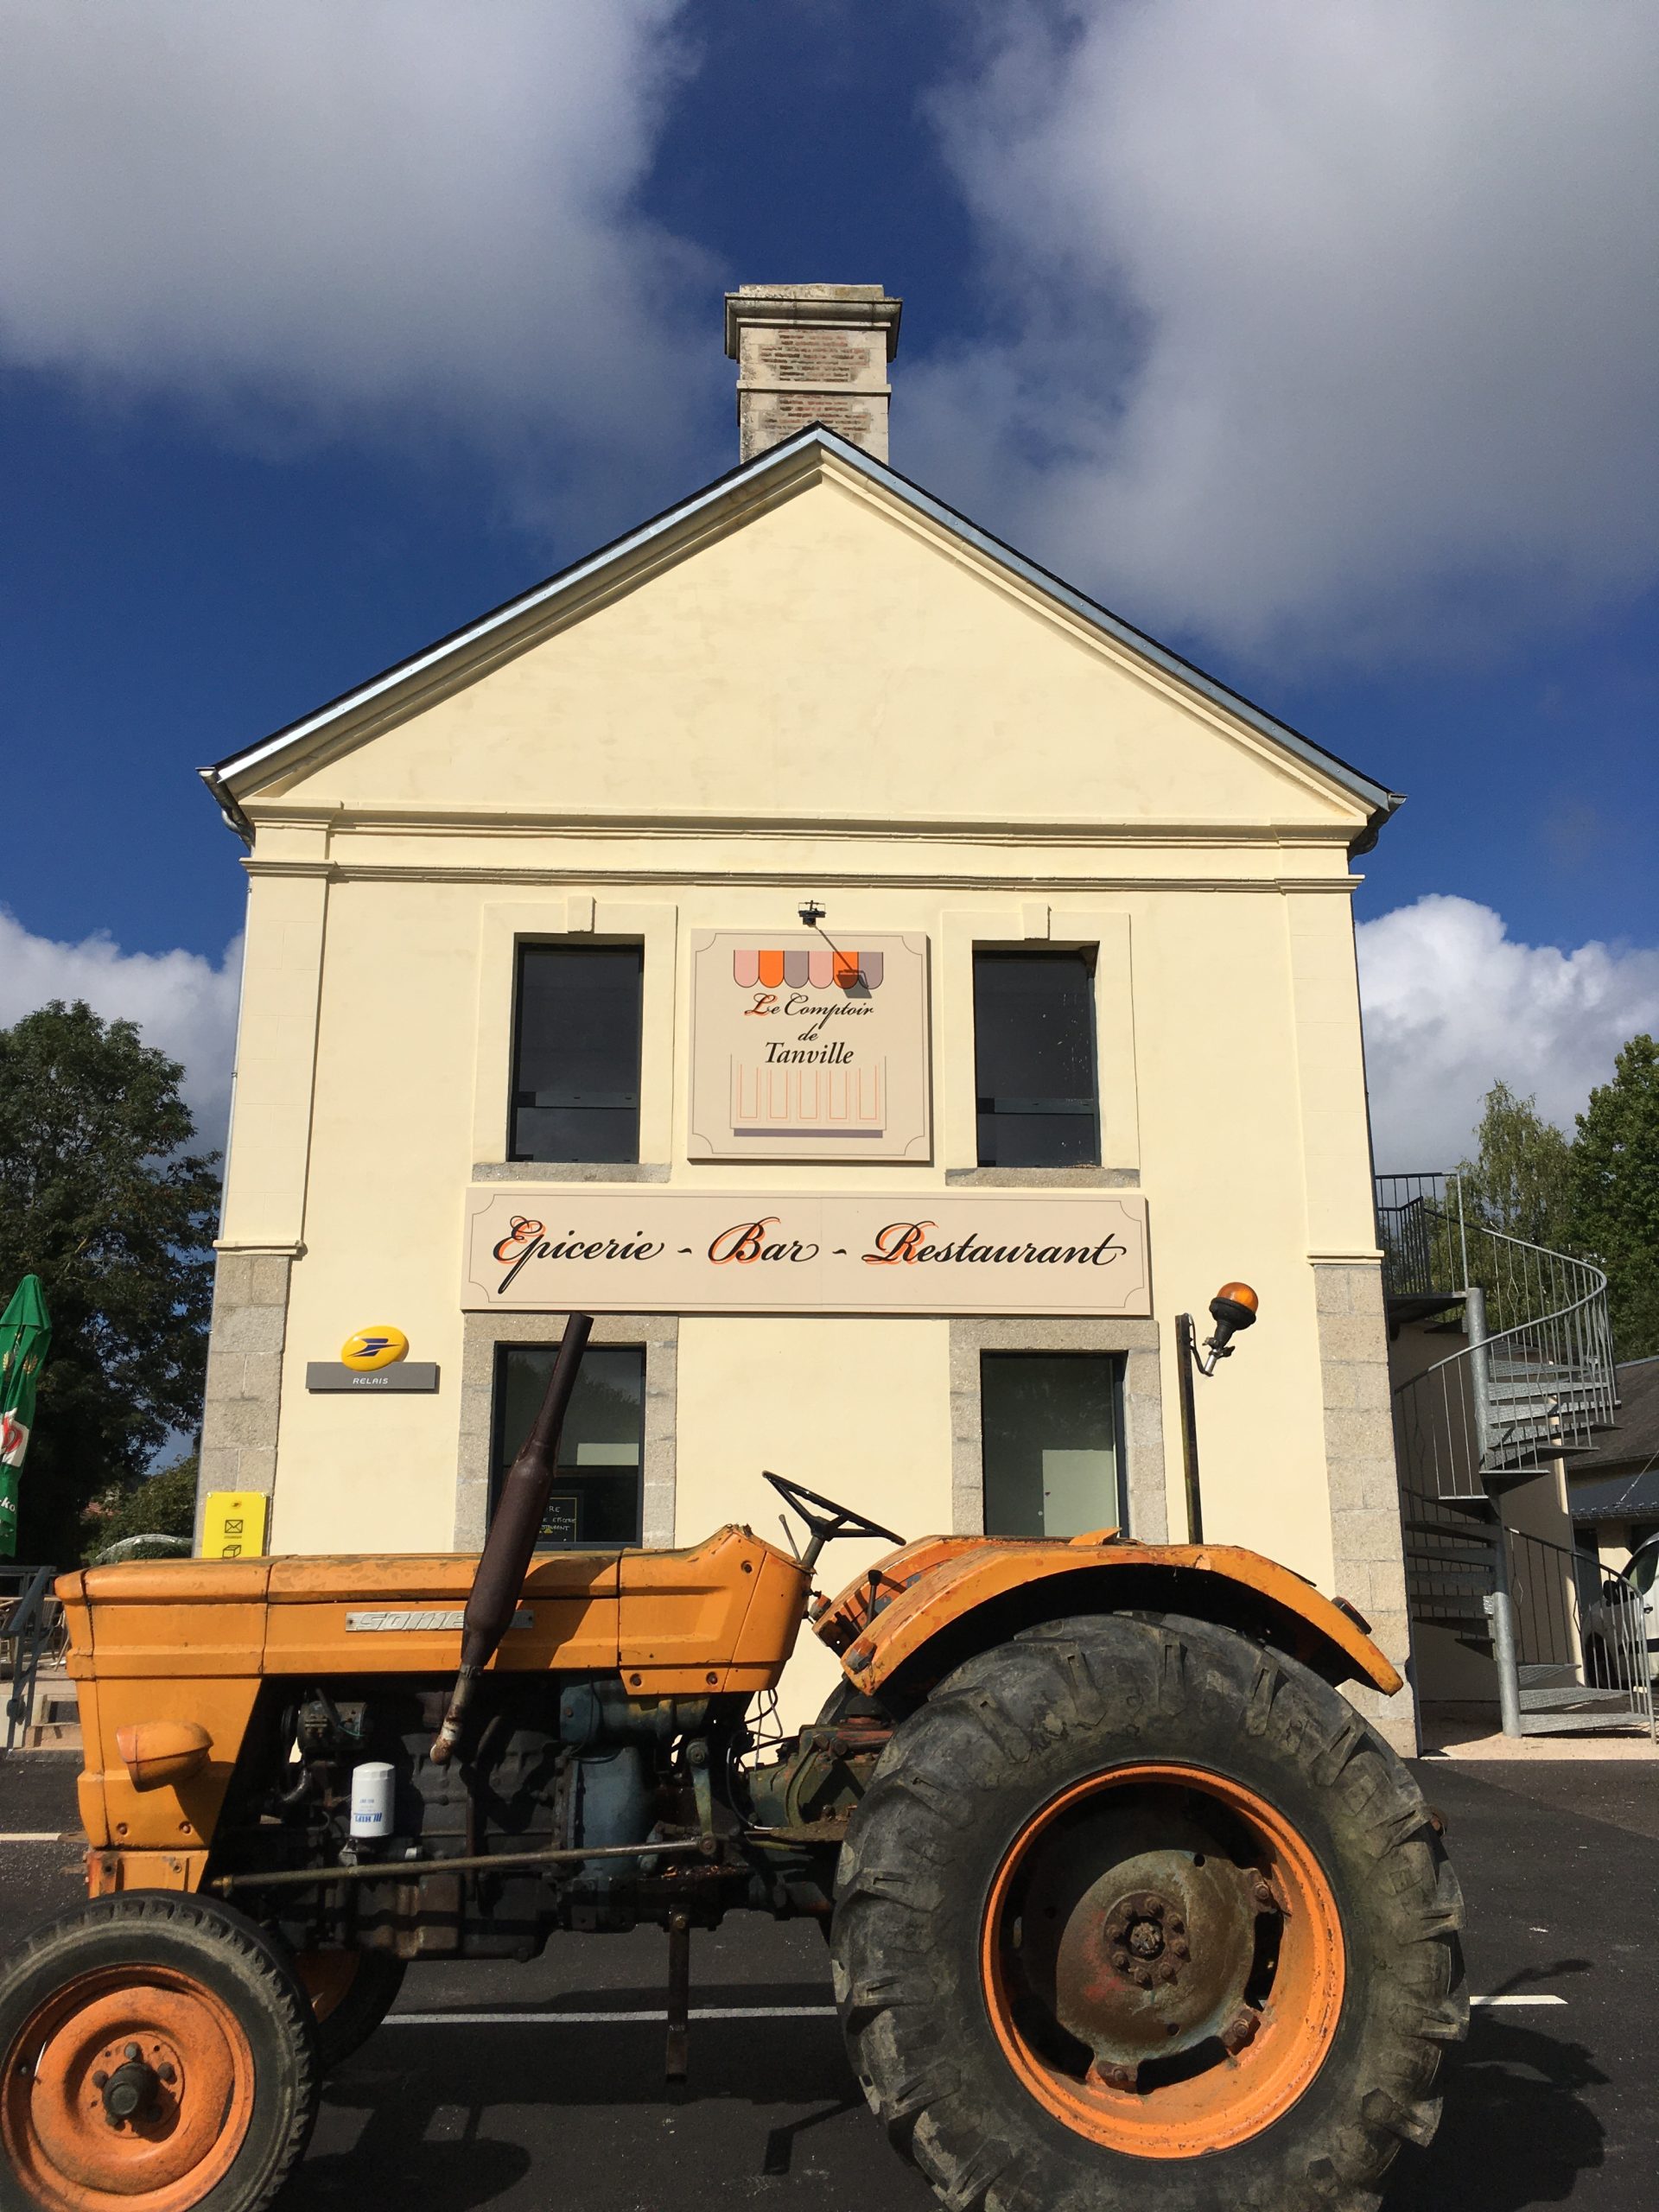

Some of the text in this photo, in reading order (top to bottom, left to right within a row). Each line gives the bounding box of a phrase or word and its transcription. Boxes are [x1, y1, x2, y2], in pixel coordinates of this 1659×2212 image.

[744, 992, 874, 1030] Le Comptoir
[798, 1023, 820, 1041] de
[764, 1041, 855, 1065] Tanville
[493, 1216, 664, 1294] Epicerie
[708, 1217, 819, 1265] Bar
[861, 1220, 1127, 1267] Restaurant
